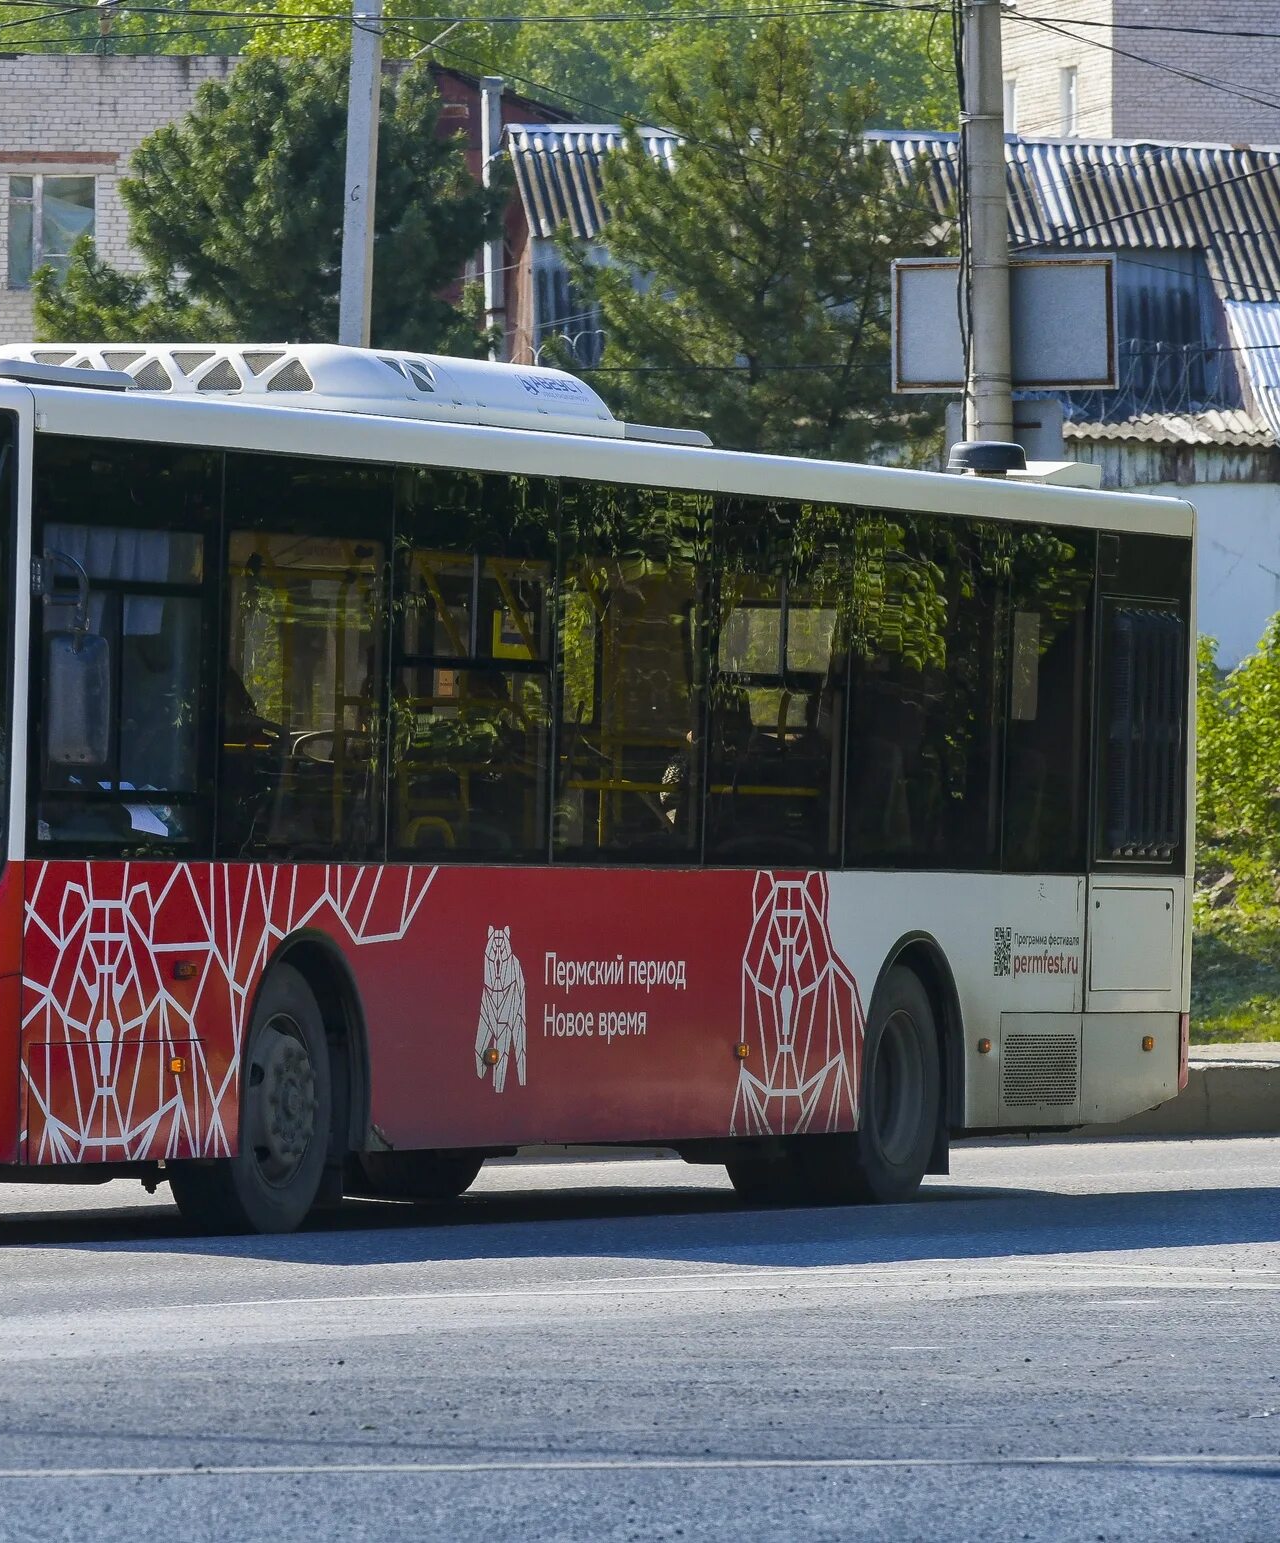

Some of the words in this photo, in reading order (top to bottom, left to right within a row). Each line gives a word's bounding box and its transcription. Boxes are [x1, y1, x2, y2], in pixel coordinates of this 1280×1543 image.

[1014, 932, 1048, 948] Программа
[1048, 933, 1080, 949] фестиваля
[544, 951, 624, 995] Пермский
[628, 960, 687, 994] период
[1013, 949, 1079, 980] permfest.ru
[543, 1003, 594, 1037] Новое
[598, 1011, 647, 1045] время
